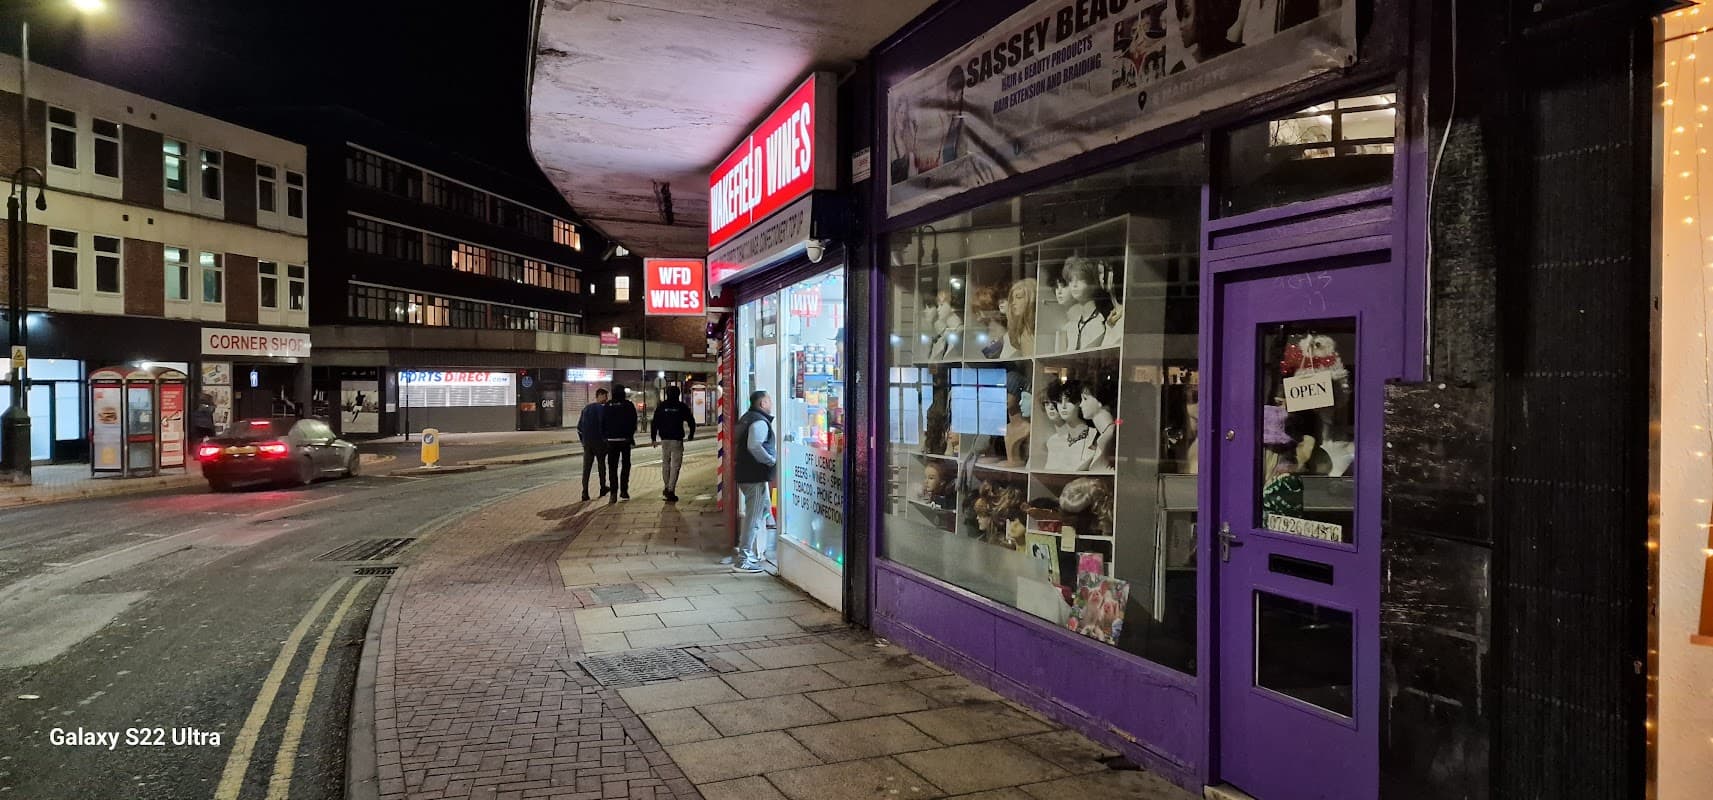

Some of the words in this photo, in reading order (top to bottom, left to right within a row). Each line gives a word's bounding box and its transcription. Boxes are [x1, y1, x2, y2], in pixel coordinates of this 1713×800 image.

[966, 17, 1050, 88] SASSEY
[1002, 73, 1017, 92] HAIR
[1024, 55, 1050, 80] BEAUTY
[1051, 35, 1093, 71] PRODUCTS
[993, 98, 1008, 115] HAIR
[1009, 79, 1045, 110] EXTENSION
[1047, 72, 1062, 92] AND
[1062, 53, 1102, 84] BRAIDING
[710, 146, 763, 234] WAKEFIELD
[766, 102, 811, 197] WINES
[658, 266, 692, 285] WFD
[650, 289, 700, 309] WINES
[210, 334, 268, 350] CORNER
[1290, 383, 1326, 399] OPEN
[795, 465, 808, 479] BEERS
[805, 453, 814, 465] OFF
[815, 456, 836, 472] LICENCE
[792, 493, 800, 506] TOP
[801, 496, 809, 510] UPS
[793, 480, 813, 496] TOBACCO
[816, 487, 833, 504] PHONE
